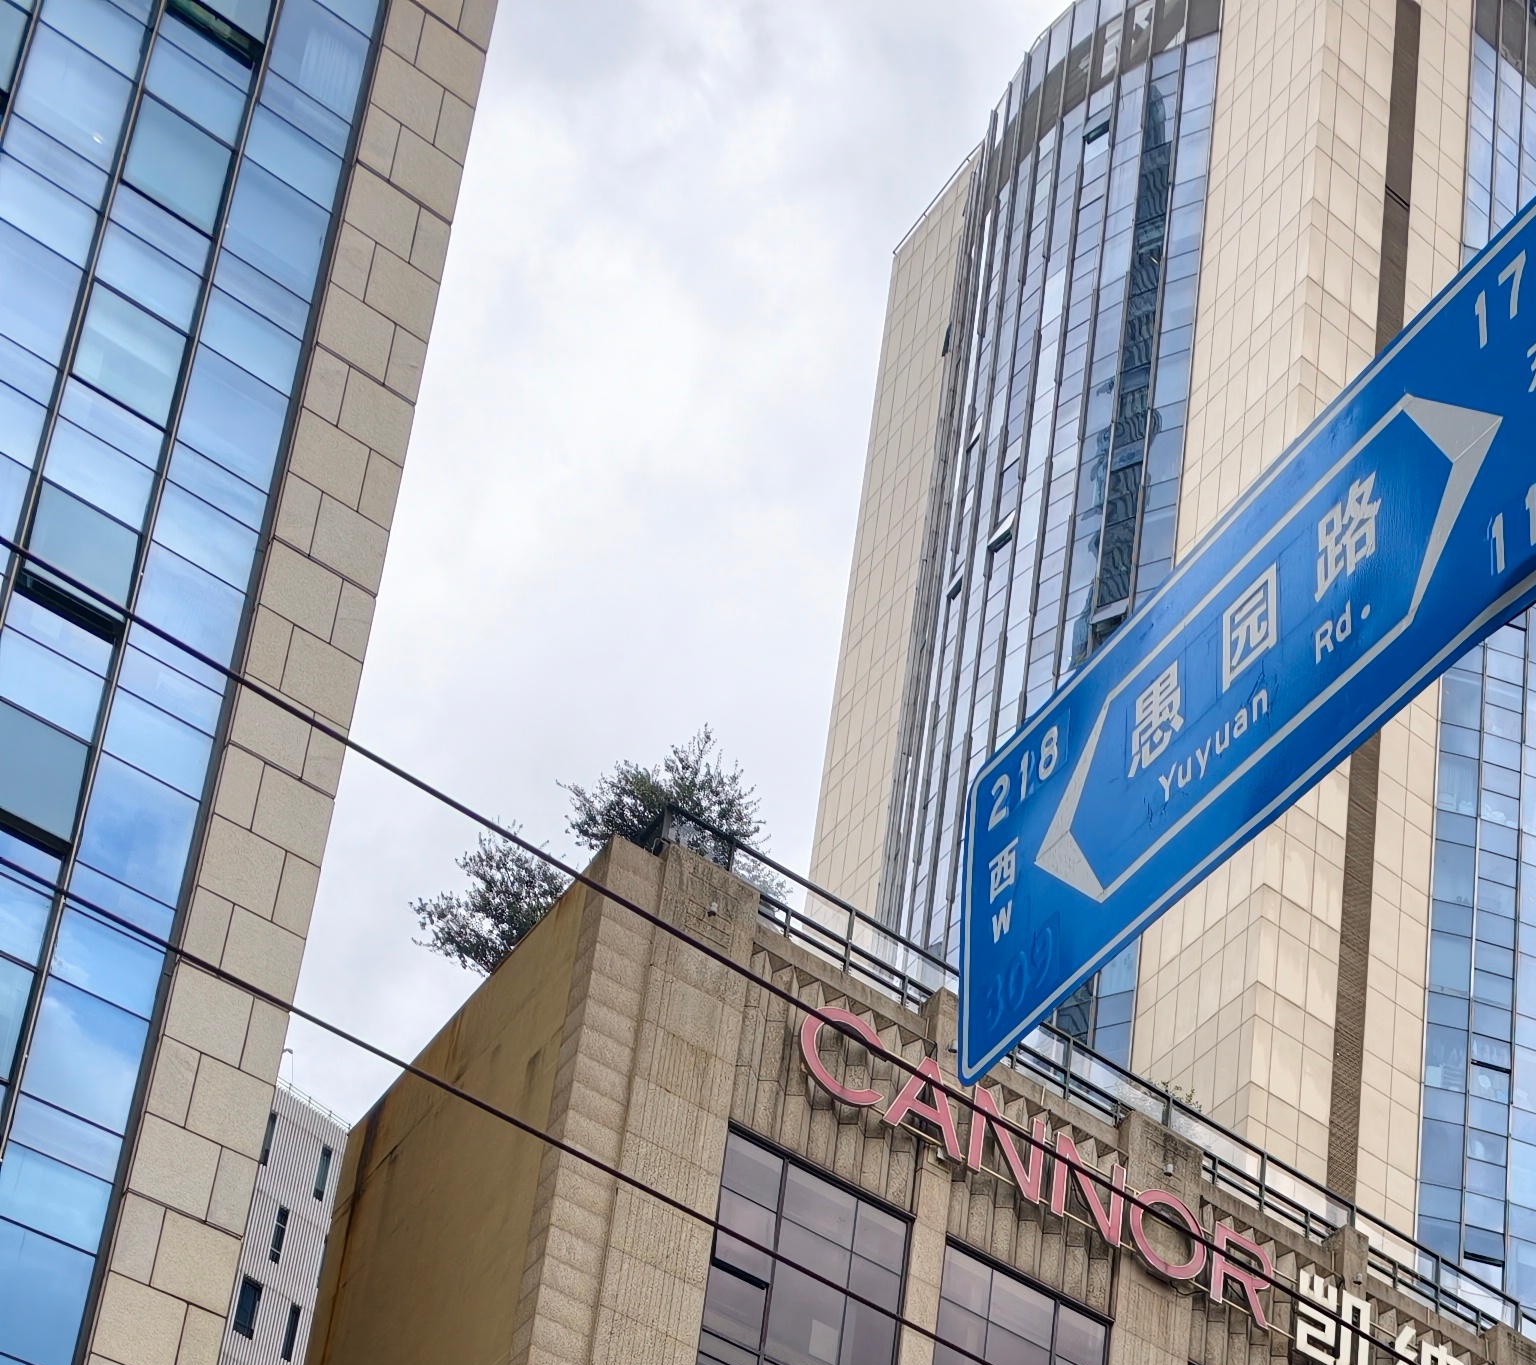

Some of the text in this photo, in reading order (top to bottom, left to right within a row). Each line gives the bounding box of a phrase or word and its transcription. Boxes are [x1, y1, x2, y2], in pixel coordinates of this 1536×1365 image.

[1126, 470, 1382, 778] 愚园路
[988, 723, 1060, 829] 218
[1157, 601, 1373, 806] Yuyuan Rd.
[987, 845, 1017, 904] 西
[991, 900, 1012, 944] W
[799, 1005, 1273, 1329] CANNOR
